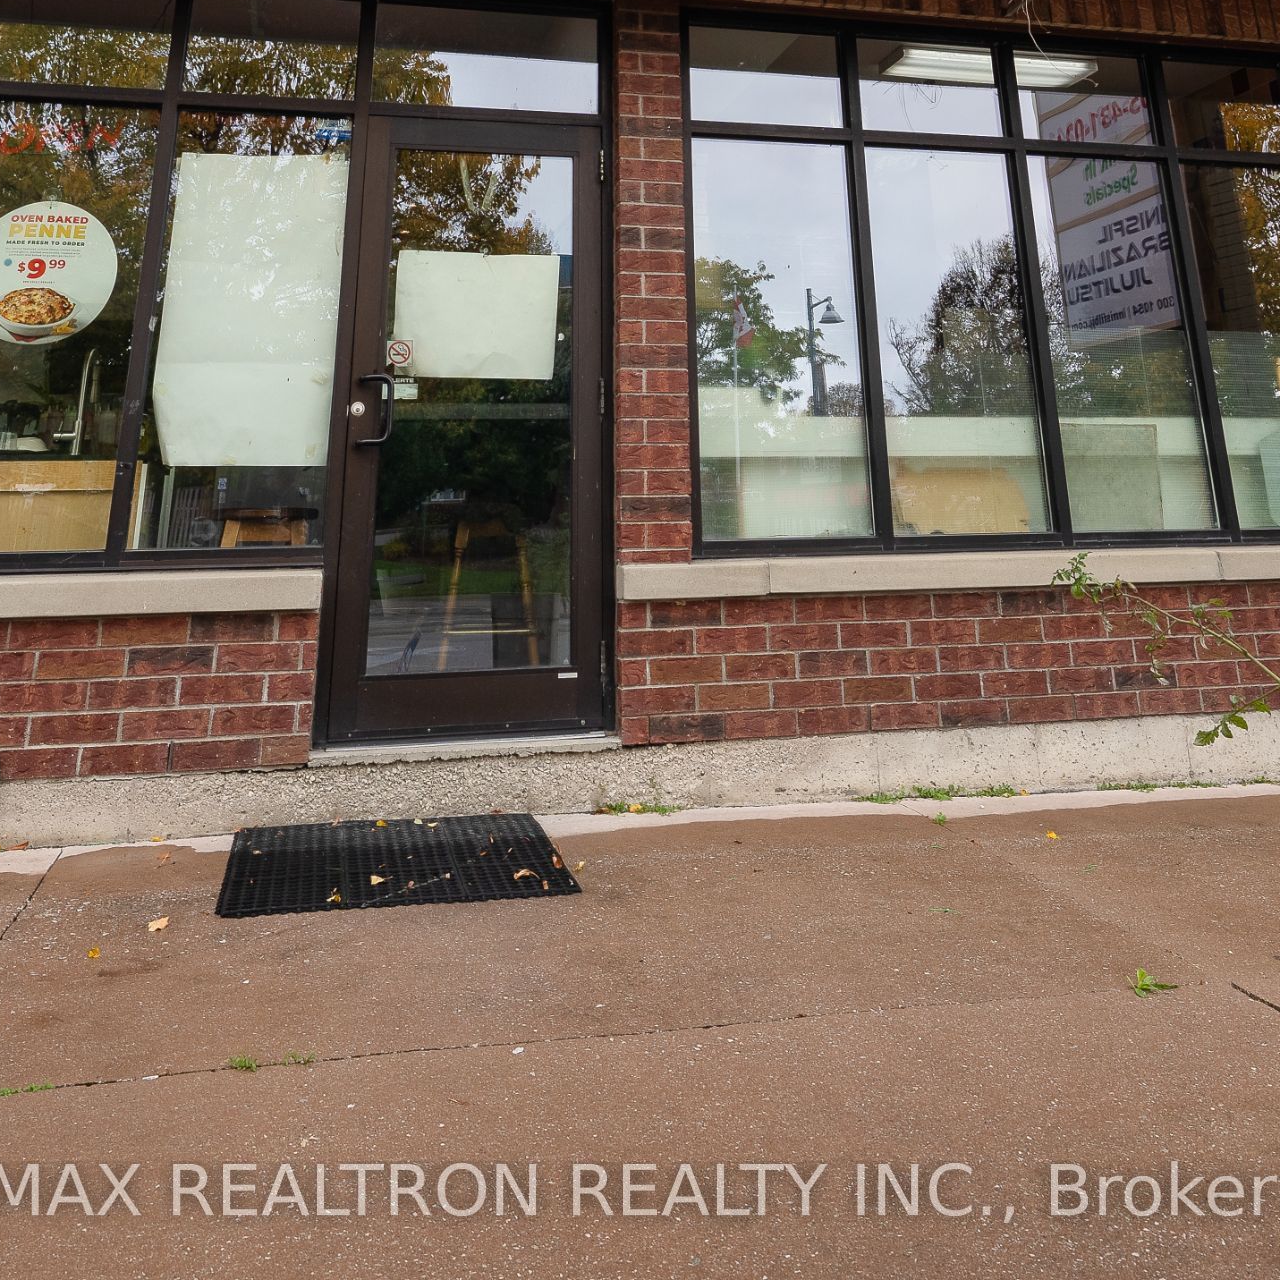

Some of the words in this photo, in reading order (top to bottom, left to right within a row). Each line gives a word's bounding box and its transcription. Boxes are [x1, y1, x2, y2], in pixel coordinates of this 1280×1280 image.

[11, 214, 43, 223] OVEN
[47, 215, 89, 224] BAKED
[8, 223, 87, 240] PENNE
